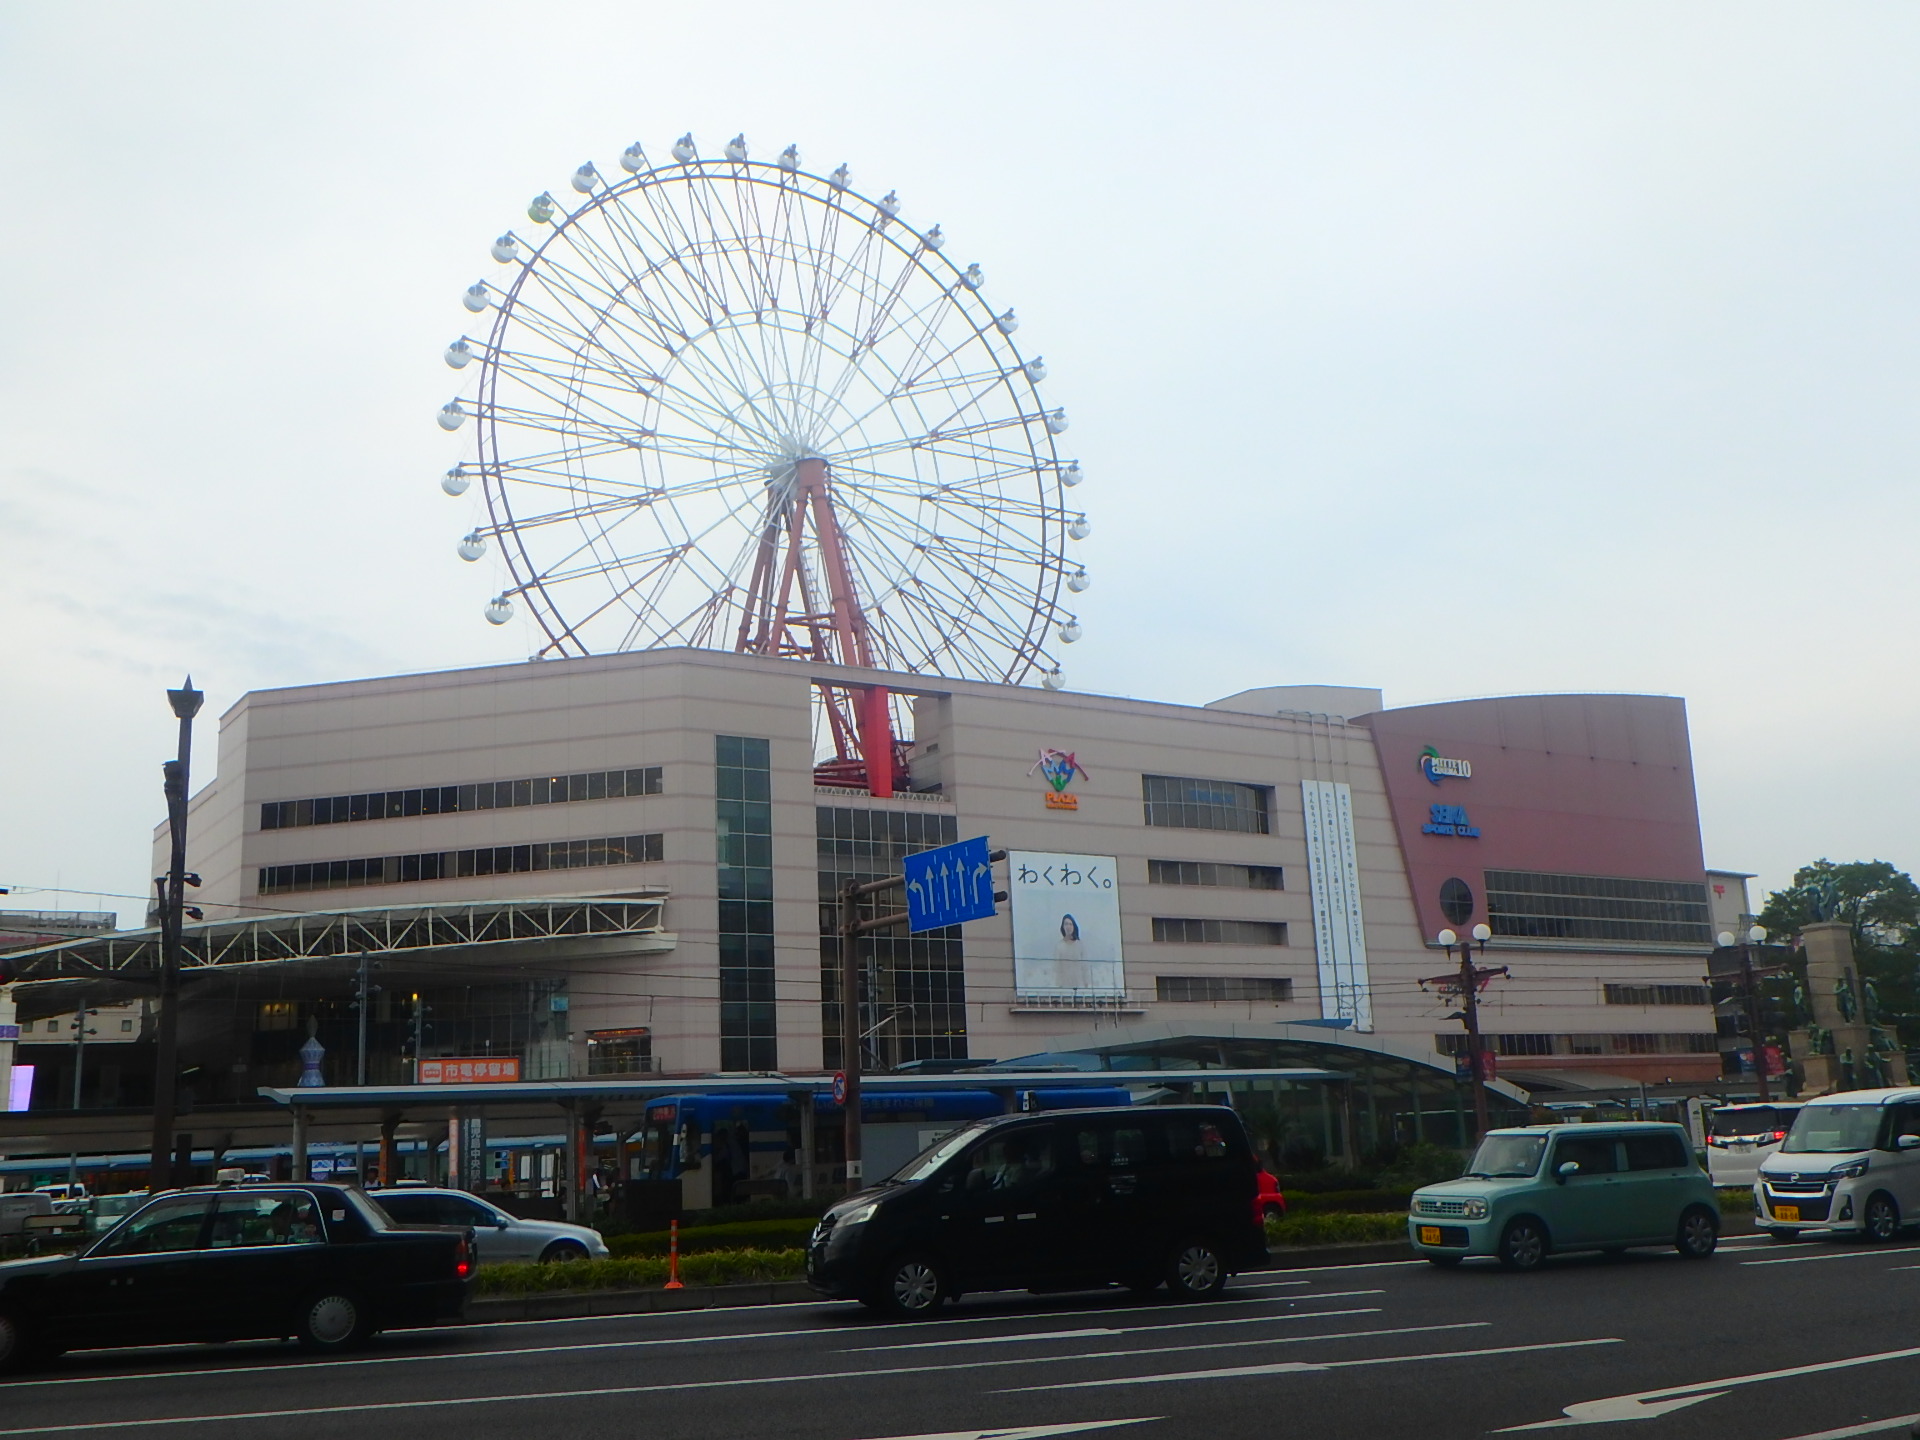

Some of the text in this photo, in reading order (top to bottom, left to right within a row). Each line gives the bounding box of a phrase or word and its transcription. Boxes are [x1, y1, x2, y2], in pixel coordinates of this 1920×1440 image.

[1457, 760, 1472, 778] 10
[1046, 792, 1078, 804] PLAZA
[1018, 863, 1112, 890] わくわく。
[446, 1063, 515, 1077] 市電停留場
